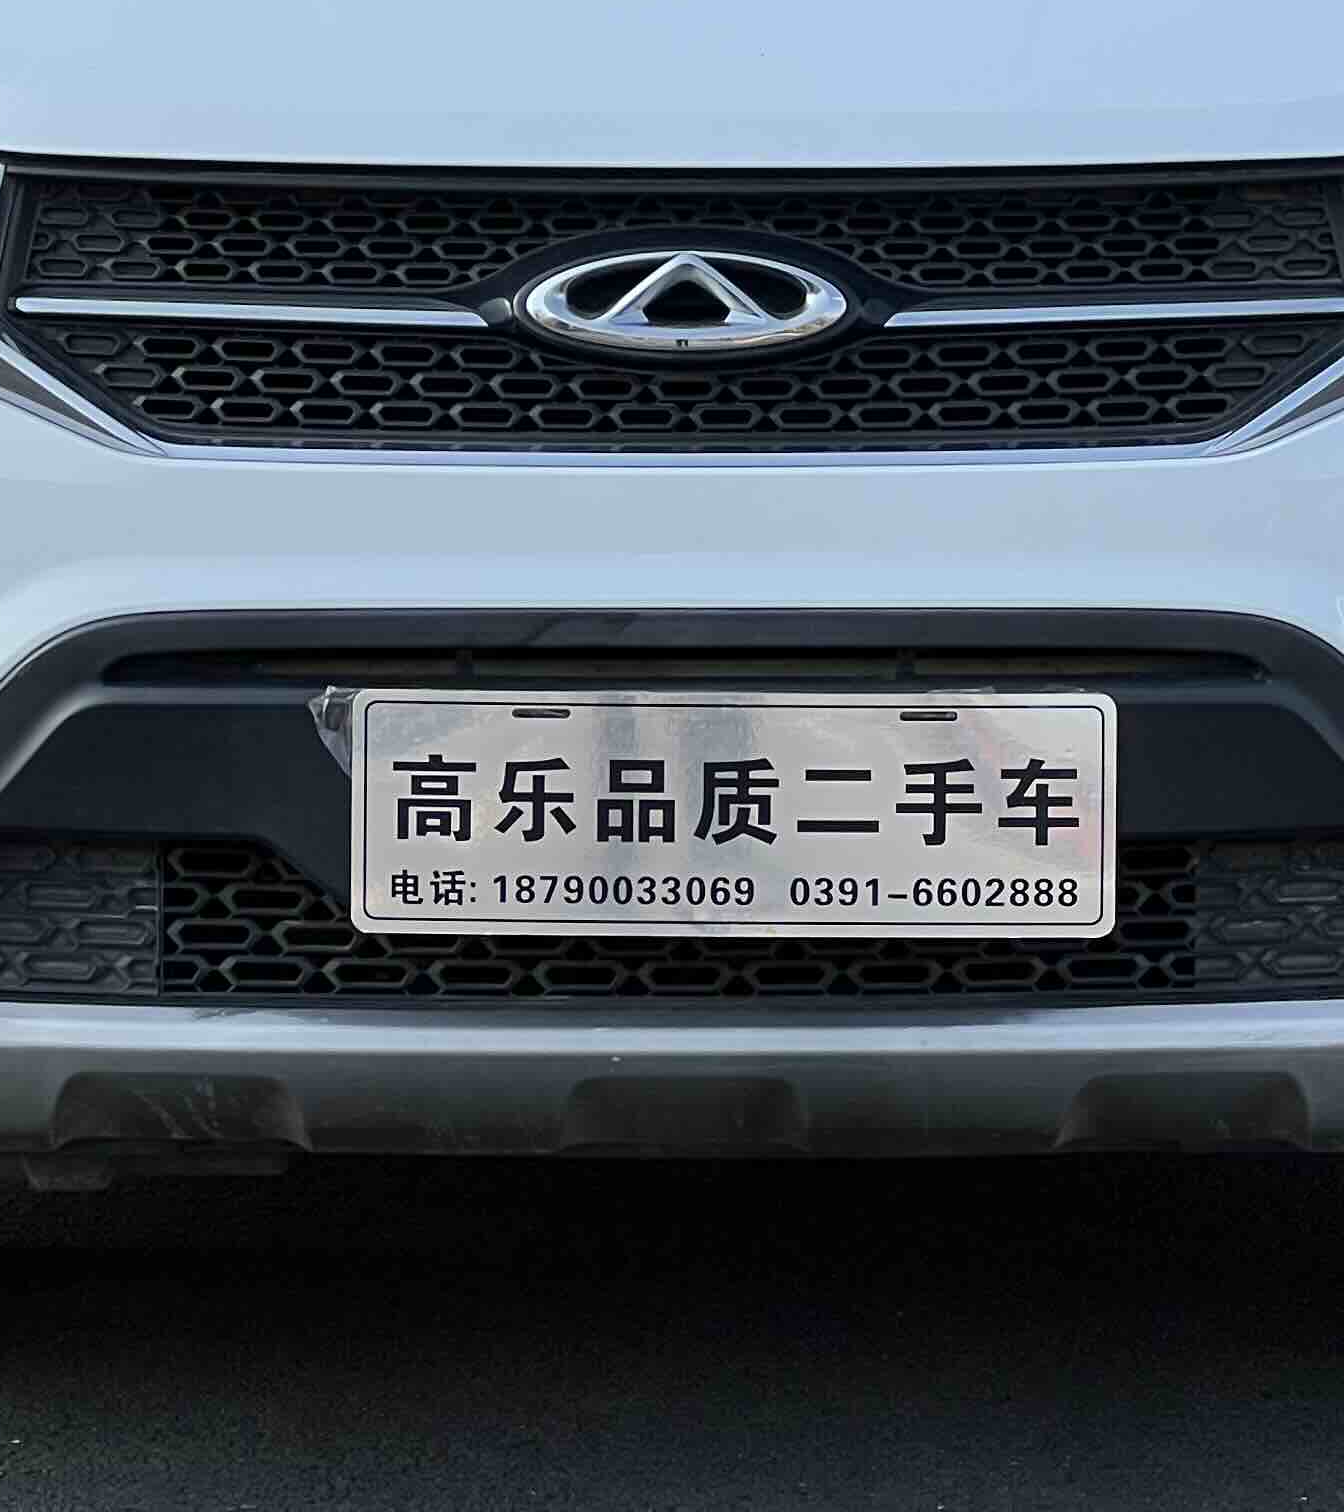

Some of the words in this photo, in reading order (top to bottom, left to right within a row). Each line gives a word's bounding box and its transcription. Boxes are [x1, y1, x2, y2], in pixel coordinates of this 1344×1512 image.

[391, 753, 1081, 847] 高乐品质二手车
[492, 874, 756, 907] 18790033069
[789, 876, 1079, 908] 0391-6602888
